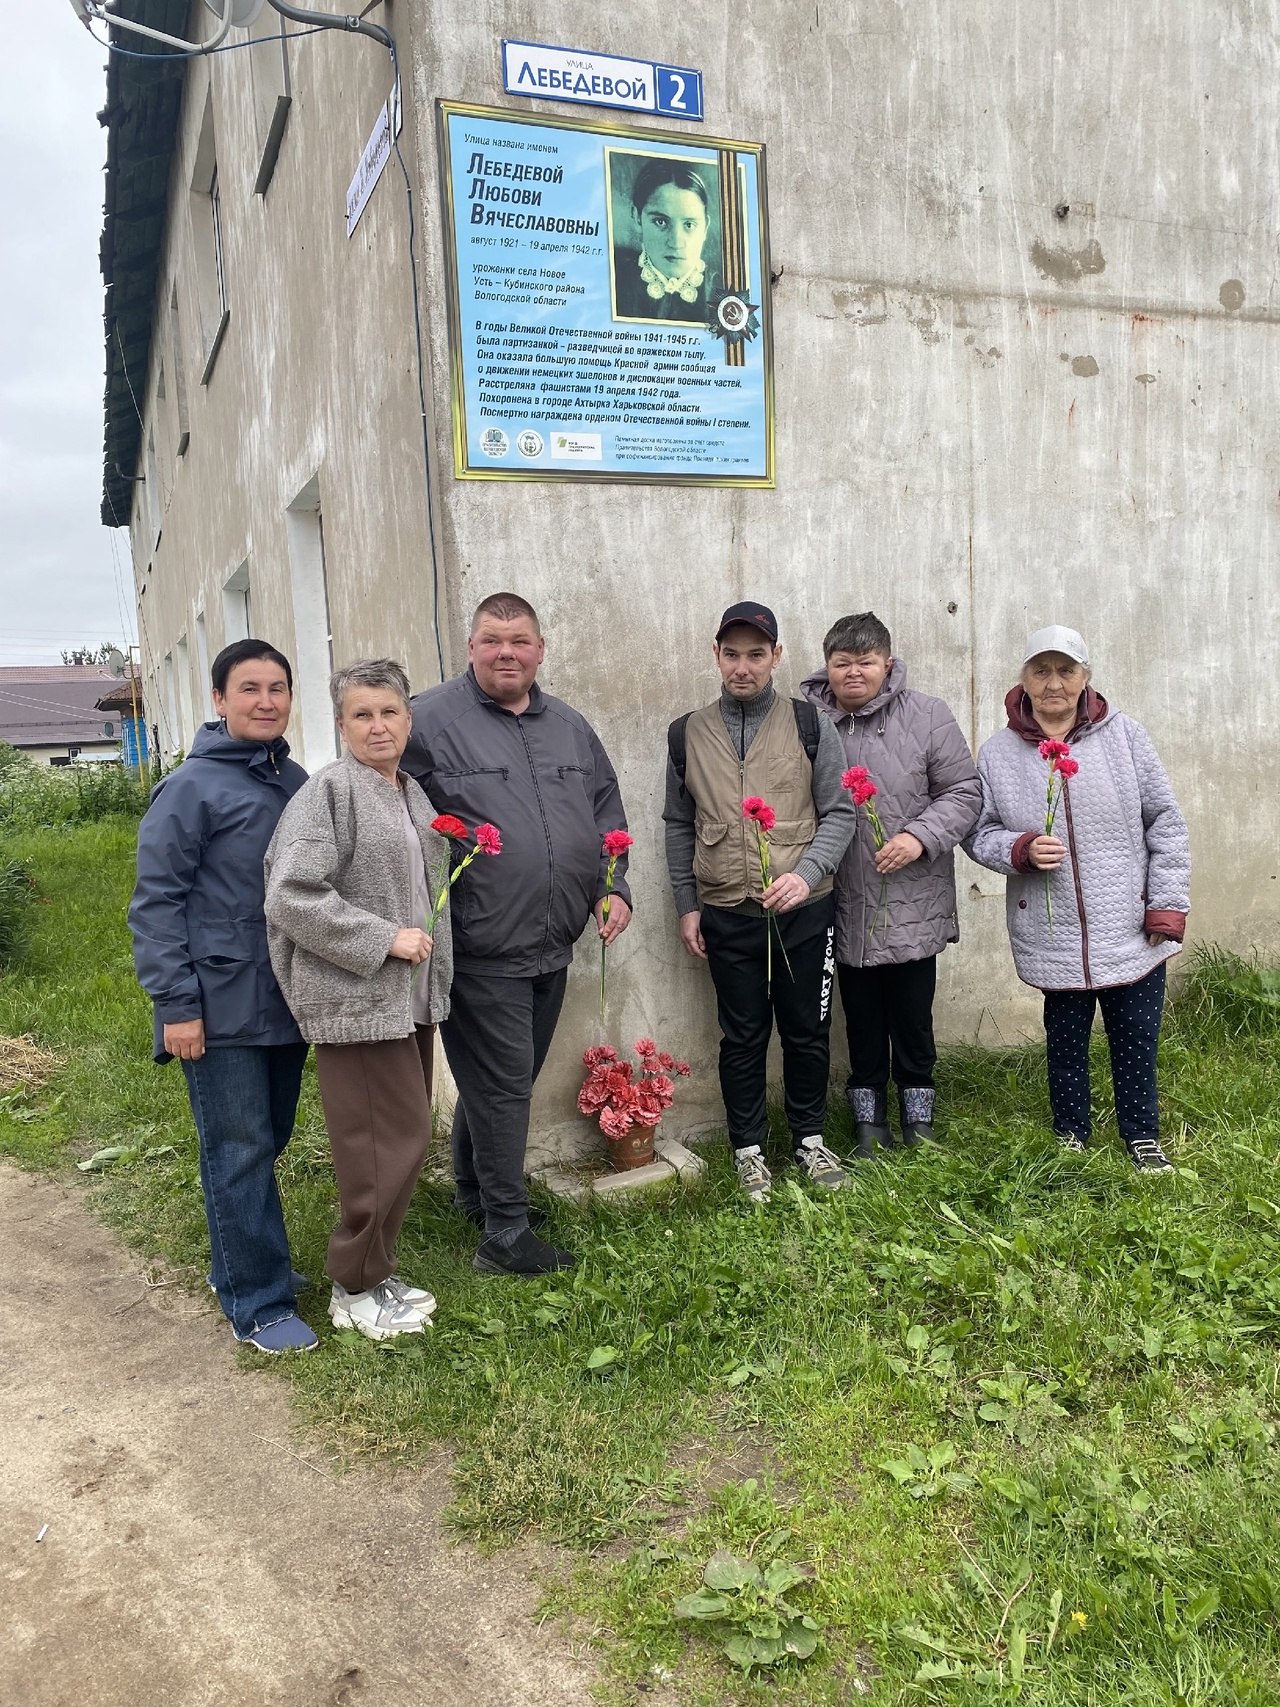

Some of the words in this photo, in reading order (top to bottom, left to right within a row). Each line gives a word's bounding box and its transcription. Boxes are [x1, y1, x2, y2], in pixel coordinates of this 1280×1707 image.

[566, 59, 594, 70] УЛИЦА
[517, 62, 646, 101] ЛЕБЕДЕВОЙ
[670, 74, 686, 110] 2
[464, 133, 490, 146] Улица
[492, 139, 525, 150] названа
[526, 143, 558, 154] именем
[466, 152, 564, 184] ЛЕБЕДЕВОЙ
[468, 178, 542, 206] ЛЮБОВИ
[470, 202, 600, 236] ВЯЧЕСЛАВОВНЫ
[470, 236, 497, 247] август
[500, 238, 519, 248] 1921
[529, 240, 540, 250] 19
[540, 242, 568, 253] апреля
[571, 244, 590, 255] 1942
[592, 248, 604, 256] г.г.
[472, 263, 515, 275] уроженки
[518, 268, 537, 276] села
[540, 268, 566, 279] Новое
[474, 276, 493, 287] Усть
[504, 278, 554, 292] Кубинского
[556, 284, 585, 295] района
[474, 290, 531, 304] Вологодской
[534, 295, 567, 306] области
[476, 320, 482, 330] В
[484, 323, 507, 333] годы
[510, 323, 546, 335] Великой
[548, 326, 612, 340] Отечественной
[614, 331, 642, 341] войны
[644, 333, 686, 345] 1941-1945
[476, 335, 500, 345] была
[502, 338, 558, 350] партизанкой
[566, 342, 622, 354] разведчицей
[624, 346, 634, 355] во
[636, 348, 682, 358] вражеском
[684, 350, 706, 360] тылу.
[477, 349, 494, 360] Она
[496, 352, 533, 362] оказала
[536, 353, 576, 366] большую
[578, 358, 612, 368] помощь
[614, 358, 649, 370] Красной
[653, 362, 679, 372] армии
[680, 363, 716, 374] сообщая
[486, 365, 530, 376] движении
[532, 368, 573, 379] немецких
[576, 371, 617, 381] эшелонов
[626, 374, 675, 385] дислокации
[677, 377, 711, 386] военных
[714, 379, 742, 388] частей.
[478, 378, 536, 391] Расстреляна
[540, 382, 591, 394] фашистами
[594, 384, 604, 394] 19
[606, 386, 636, 396] апреля
[638, 387, 658, 397] 1942
[660, 389, 681, 398] года.
[479, 392, 532, 405] Похоронена
[534, 397, 540, 405] в
[542, 397, 572, 408] городе
[574, 398, 610, 409] Ахтырка
[612, 400, 665, 411] Харьковской
[667, 402, 702, 413] области.
[480, 407, 528, 420] Посмертно
[530, 410, 582, 422] награждена
[584, 414, 621, 423] орденом
[623, 414, 684, 426] Отечественной
[686, 418, 711, 427] войны
[717, 420, 751, 429] степени.
